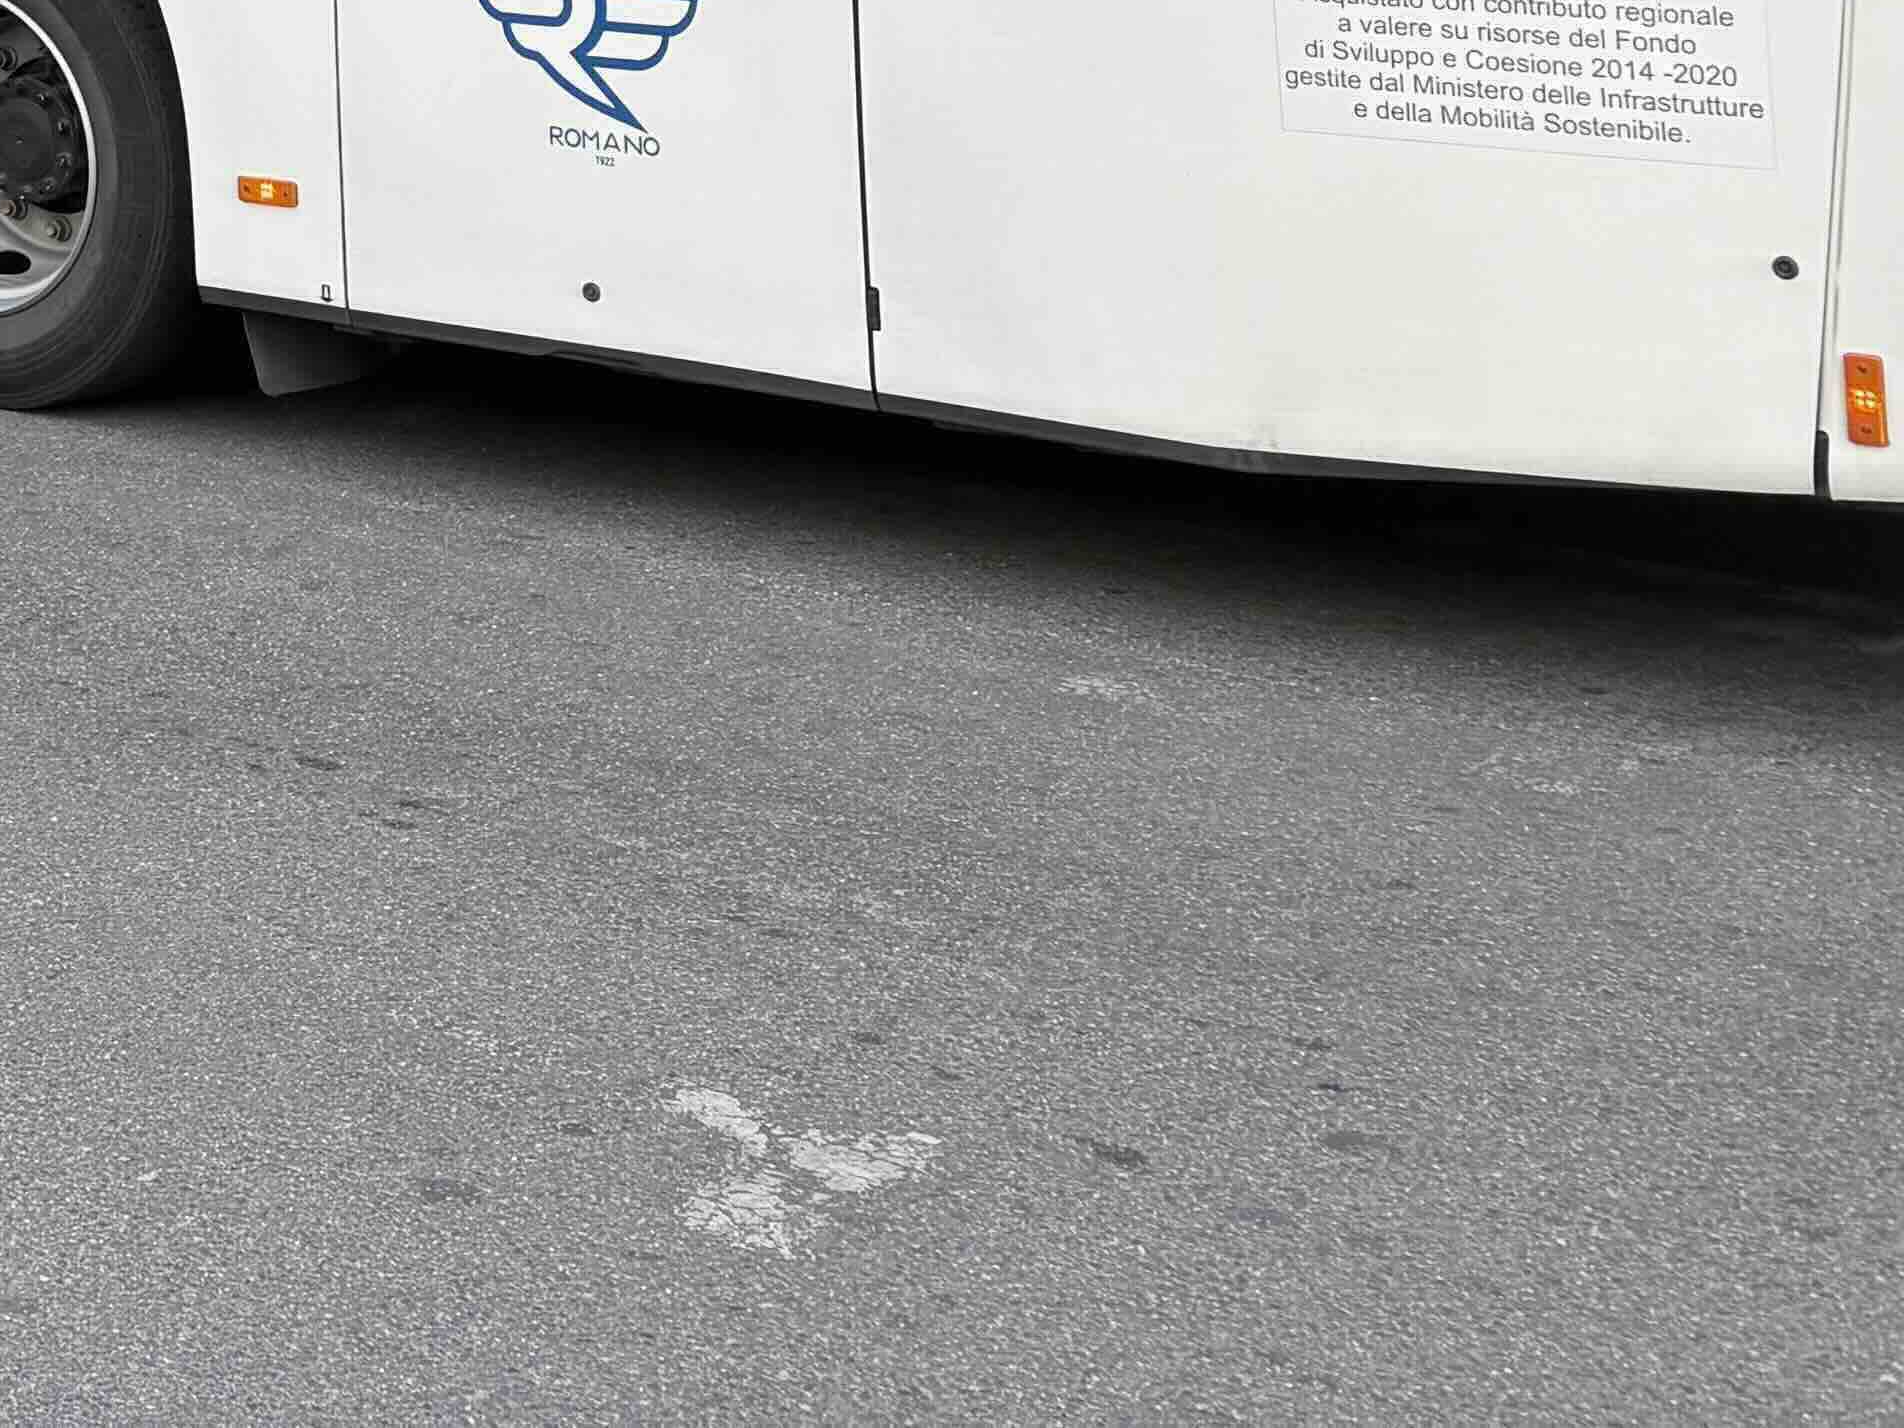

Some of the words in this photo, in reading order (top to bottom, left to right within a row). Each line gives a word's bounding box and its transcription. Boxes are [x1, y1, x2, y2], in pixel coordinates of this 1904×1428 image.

[1338, 17, 1352, 33] a
[1360, 16, 1432, 37] valere
[1440, 23, 1469, 40] su
[1478, 21, 1560, 46] risorse
[1569, 28, 1606, 49] del
[1615, 29, 1697, 55] Fondo
[1615, 3, 1734, 28] regionale
[1304, 40, 1325, 59] di
[1332, 40, 1434, 70] Sviluppo
[1442, 52, 1457, 68] e
[1465, 49, 1583, 77] Coesione
[1591, 57, 1656, 81] 2014
[1284, 68, 1362, 90] gestite
[1369, 72, 1404, 93] dal
[1413, 73, 1524, 102] Ministero
[1532, 84, 1592, 106] delle
[1600, 87, 1765, 120] Infrastrutture
[549, 125, 661, 157] ROMANO
[1353, 102, 1368, 118] e
[1375, 100, 1432, 123] della
[1441, 105, 1535, 132] Mobilità
[1544, 112, 1692, 144] Sostenibile.
